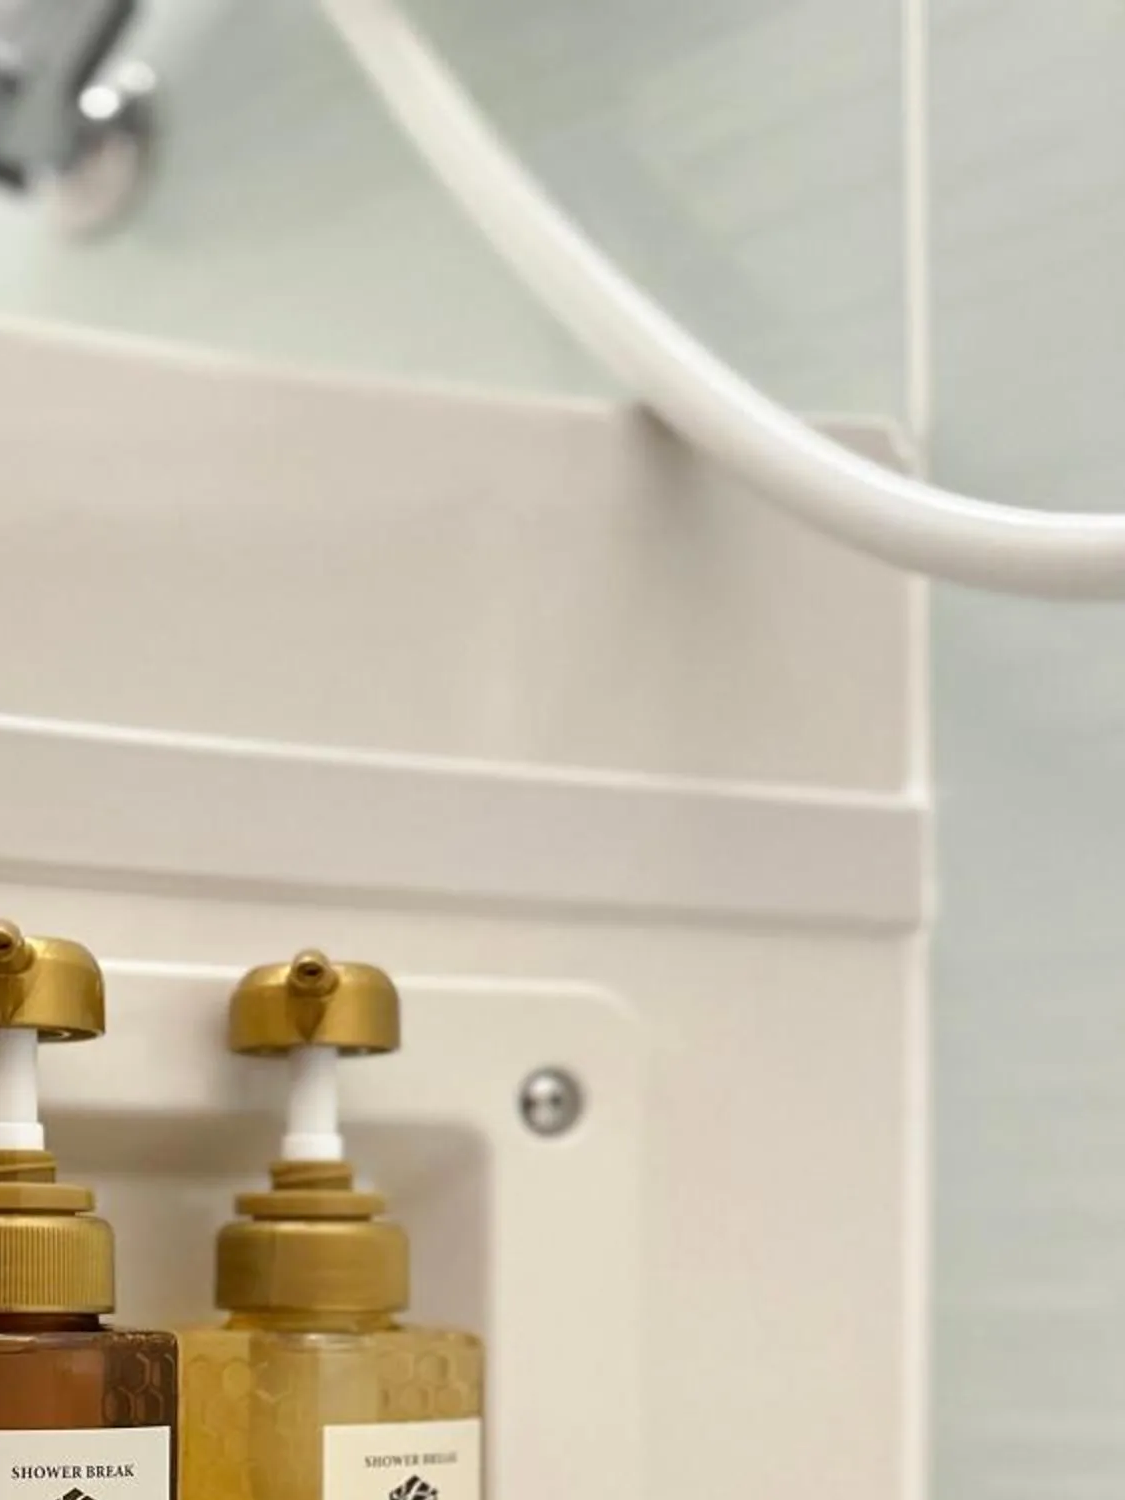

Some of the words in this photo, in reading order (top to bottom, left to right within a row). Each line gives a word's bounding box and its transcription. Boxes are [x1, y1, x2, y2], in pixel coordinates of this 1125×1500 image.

[364, 1453, 420, 1469] SHOWER
[11, 1465, 82, 1480] SHOWER
[85, 1463, 135, 1479] BREAK
